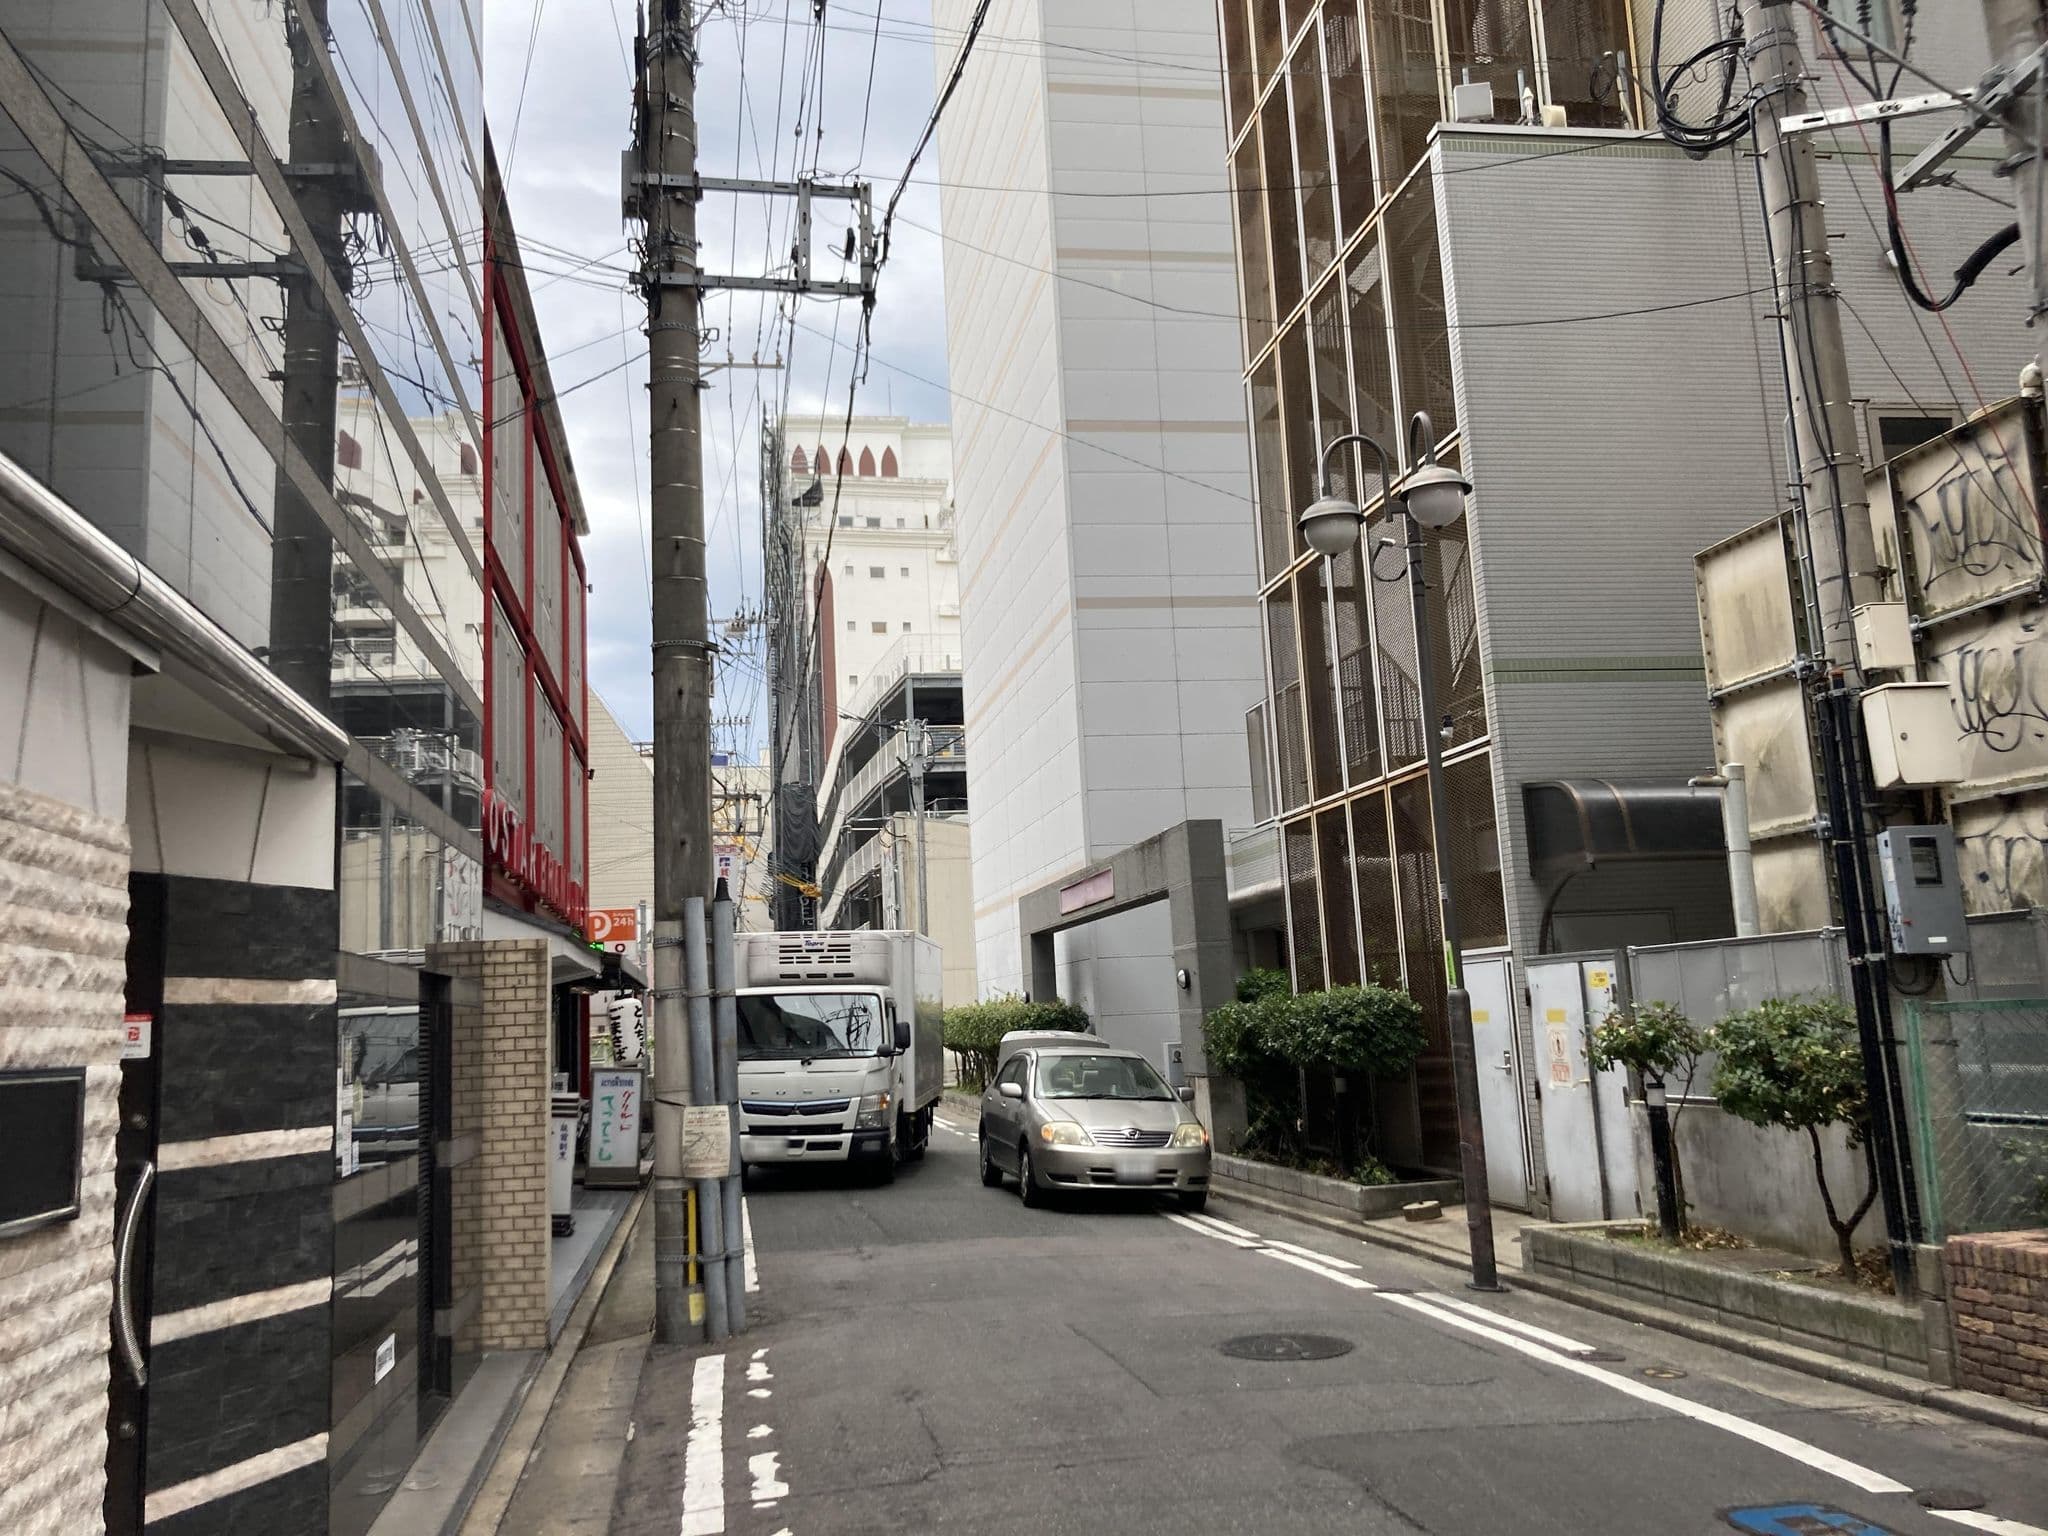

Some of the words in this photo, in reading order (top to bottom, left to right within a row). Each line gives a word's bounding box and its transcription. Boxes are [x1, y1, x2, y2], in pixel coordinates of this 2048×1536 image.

[612, 917, 634, 927] 24h
[609, 1005, 628, 1062] ごまさば
